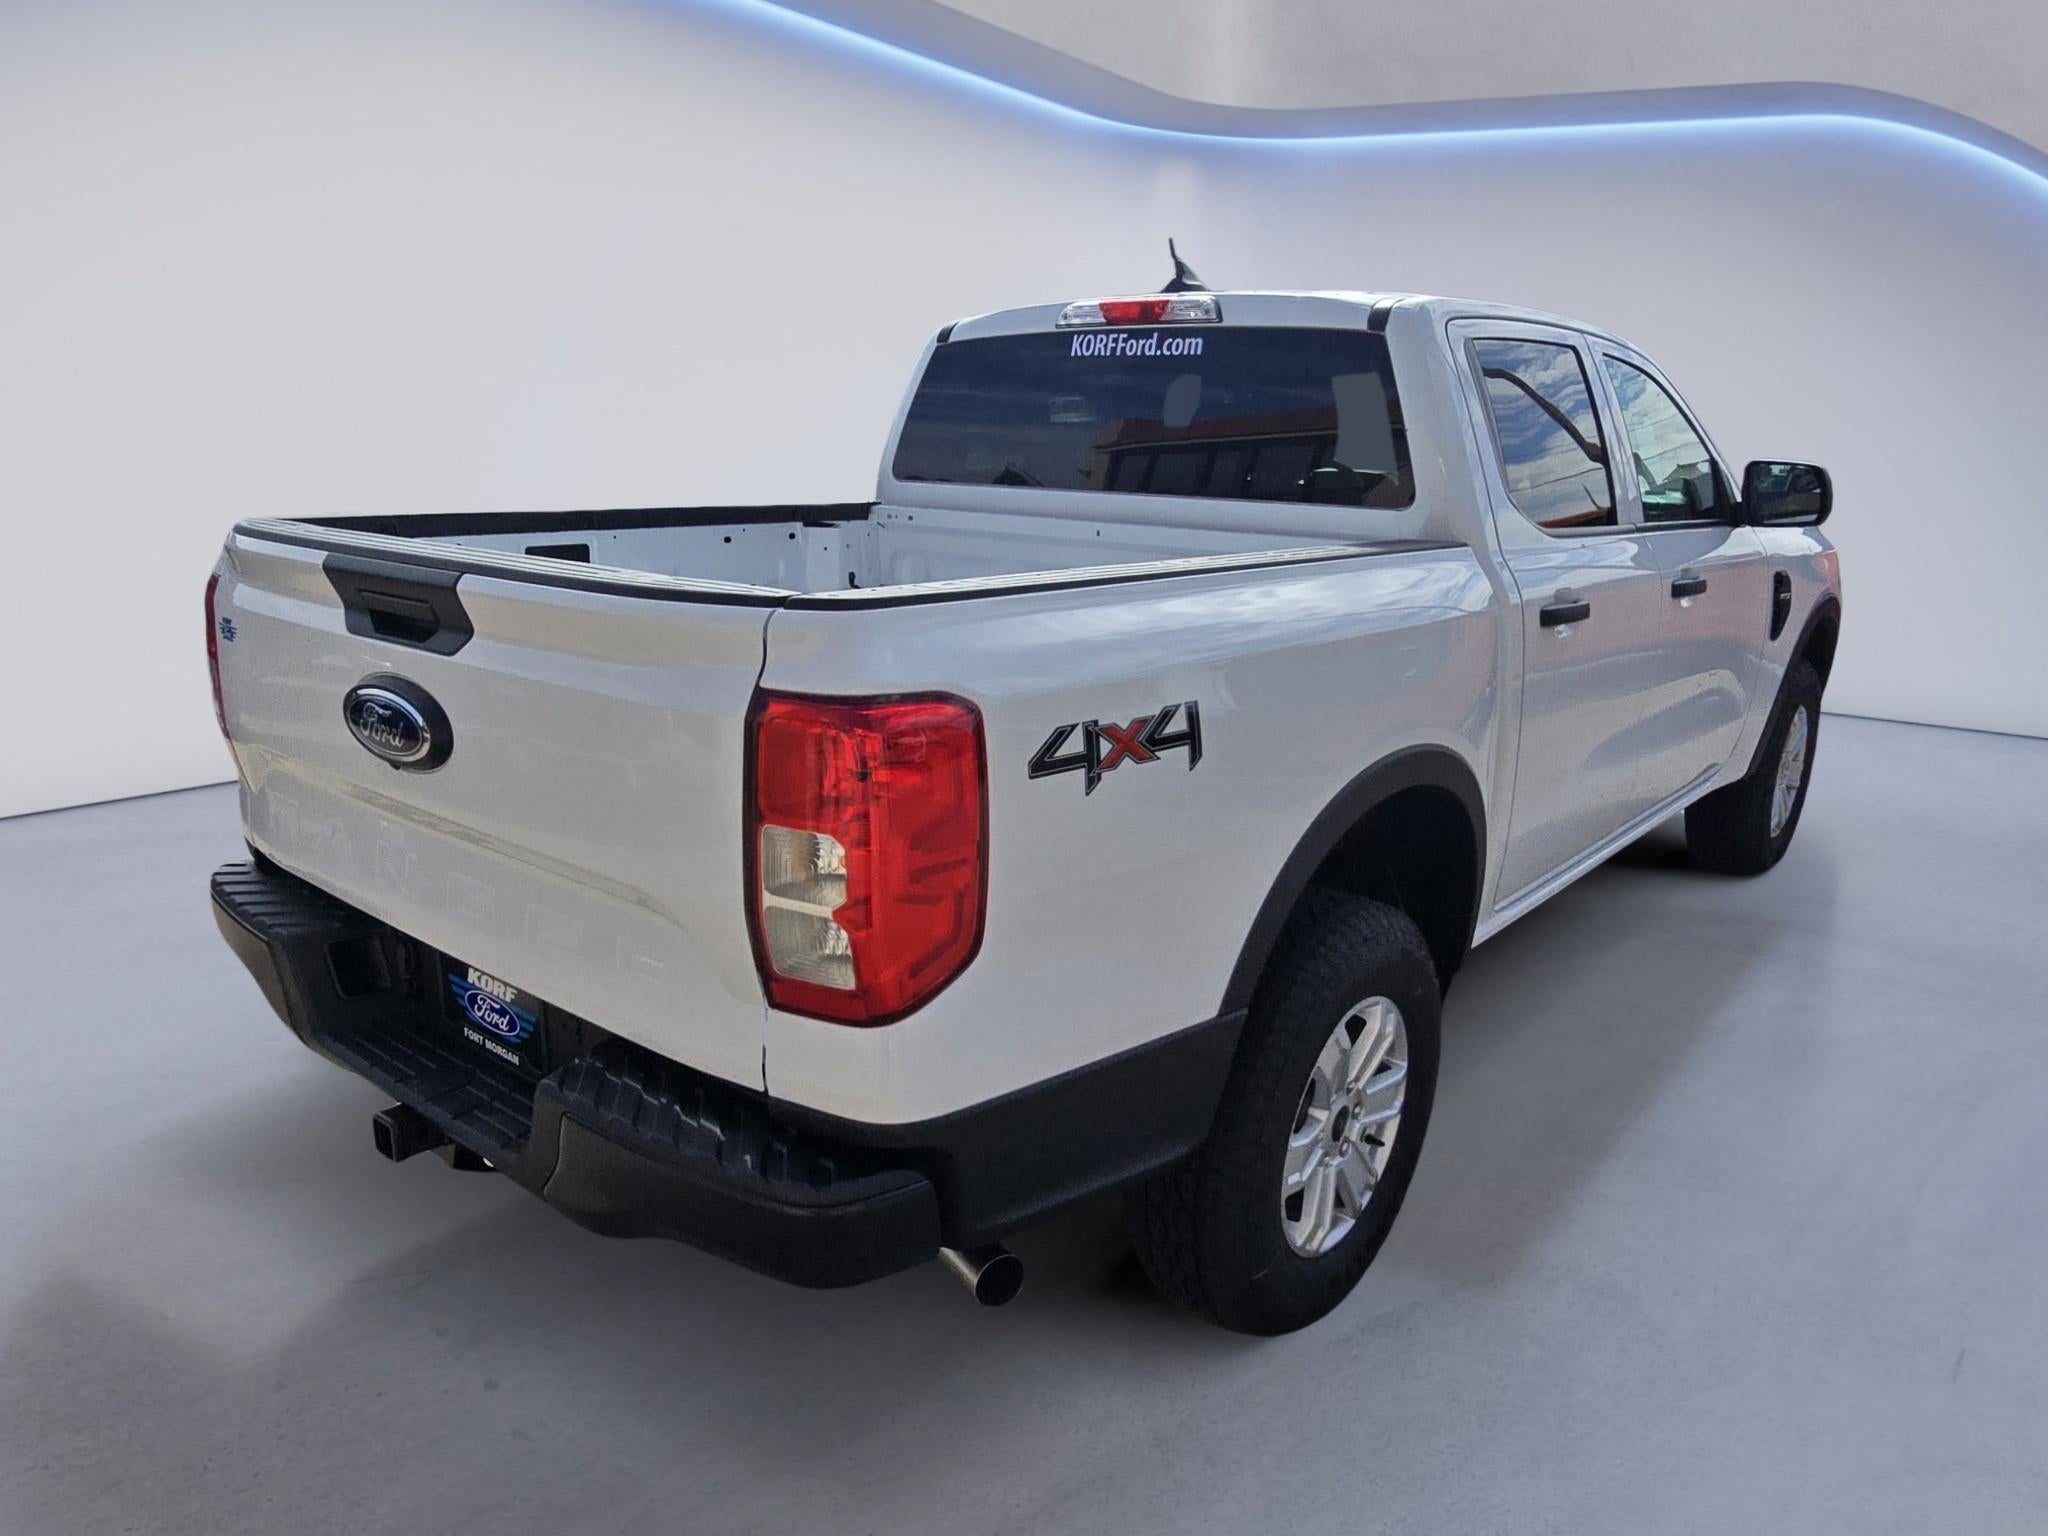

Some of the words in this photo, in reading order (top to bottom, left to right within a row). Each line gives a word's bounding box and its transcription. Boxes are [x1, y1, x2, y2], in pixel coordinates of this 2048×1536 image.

[1071, 332, 1203, 357] KORFFord.com
[360, 702, 404, 748] Ford
[467, 967, 518, 1003] KORF
[474, 994, 510, 1031] Ford
[463, 1026, 484, 1046] FORT
[484, 1038, 520, 1066] MORGAN
